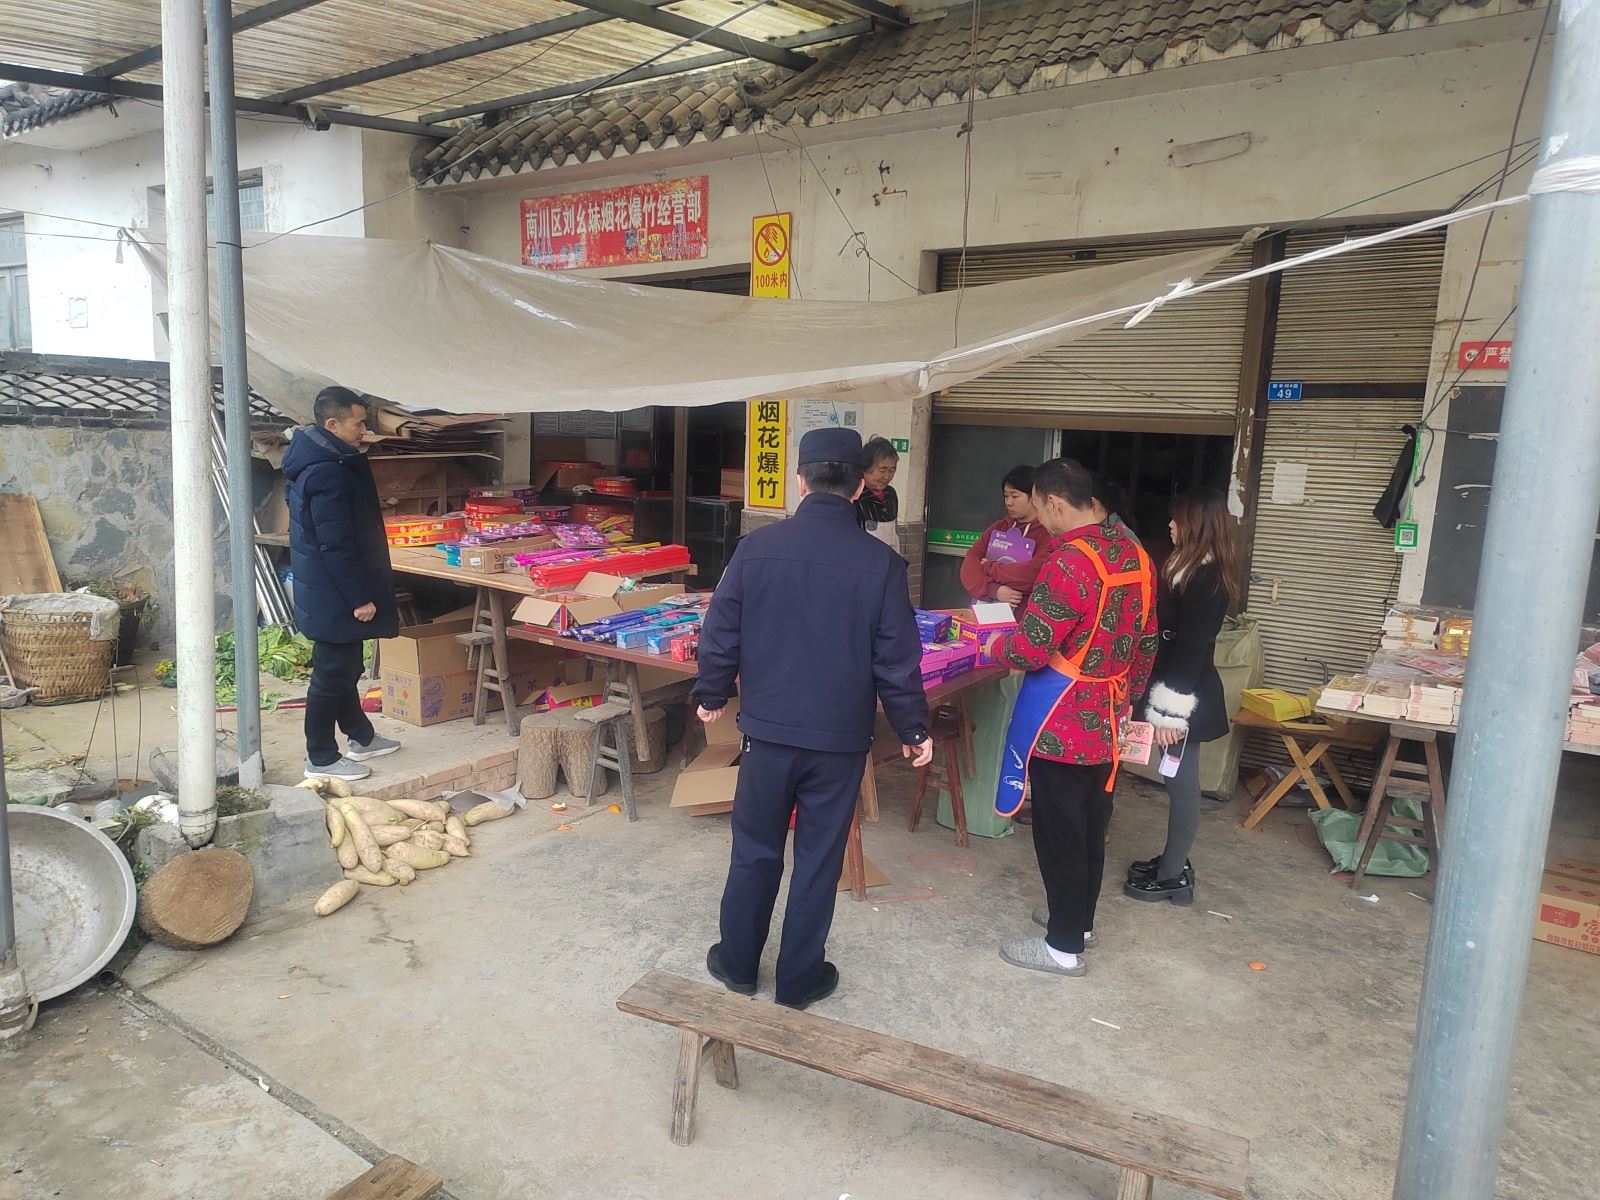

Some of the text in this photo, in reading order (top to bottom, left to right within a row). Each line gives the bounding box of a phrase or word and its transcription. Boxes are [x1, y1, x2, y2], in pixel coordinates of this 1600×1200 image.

[755, 271, 787, 289] 100米内
[1482, 346, 1512, 364] 严禁
[1276, 388, 1292, 399] 49
[757, 401, 780, 499] 烟花爆竹
